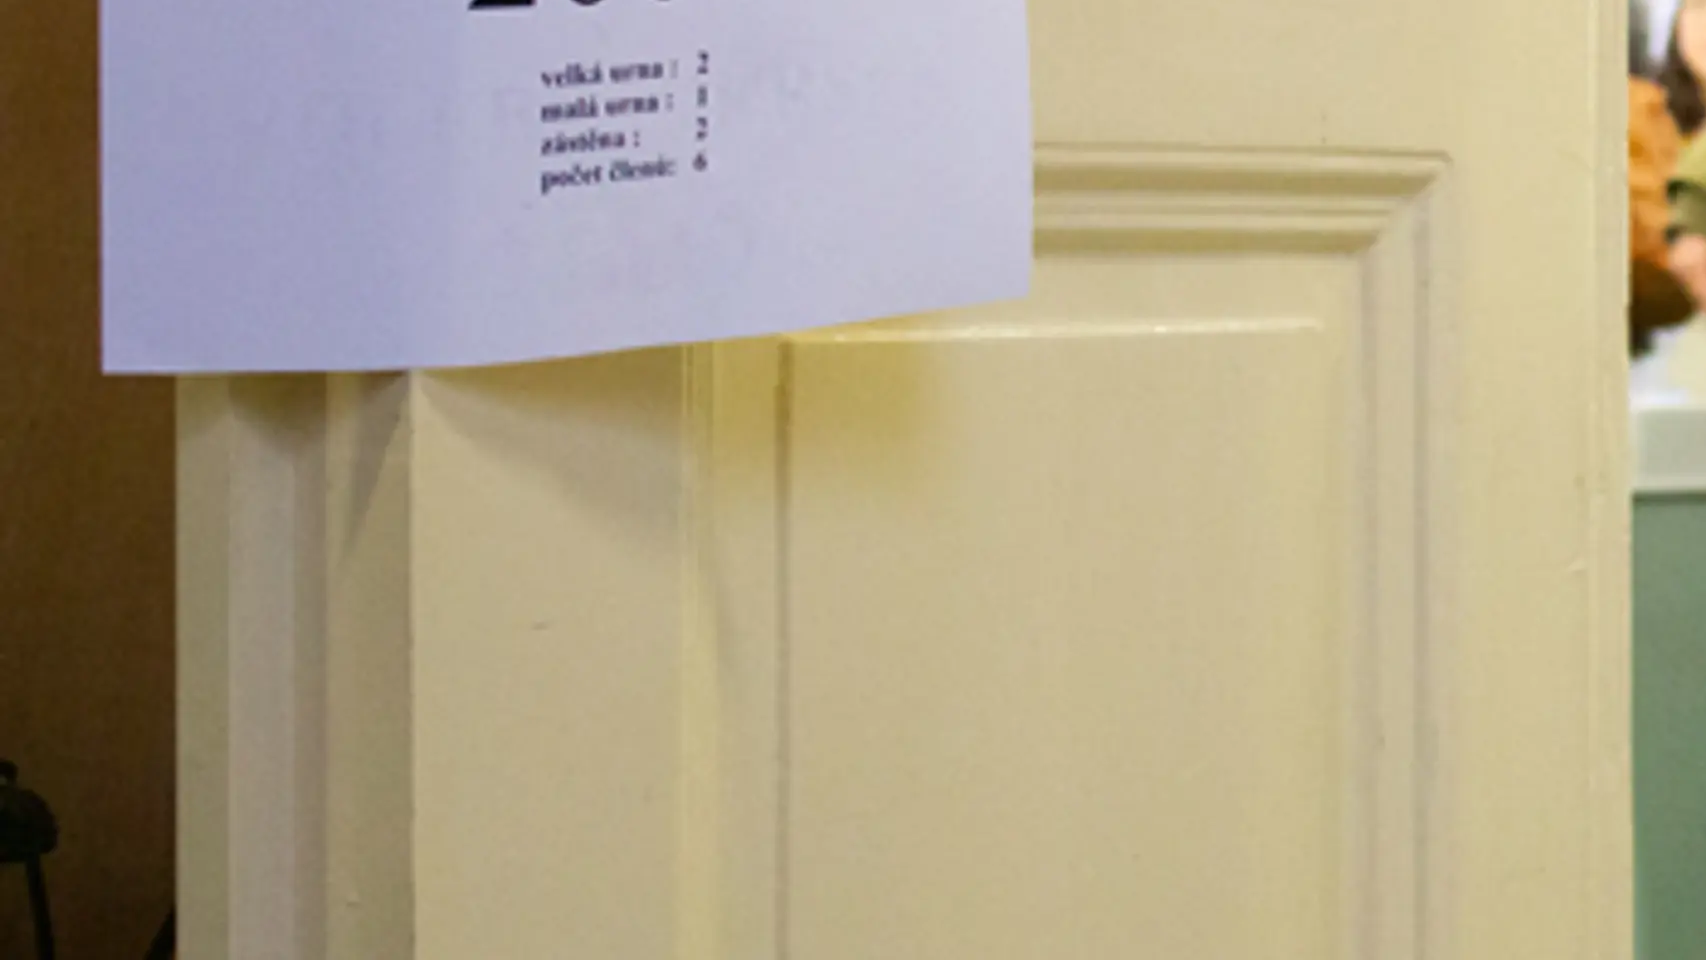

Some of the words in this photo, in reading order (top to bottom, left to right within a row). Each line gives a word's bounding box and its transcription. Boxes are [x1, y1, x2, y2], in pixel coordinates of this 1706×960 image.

[541, 60, 602, 86] velká
[609, 62, 664, 82] urna
[697, 50, 709, 74] 2
[541, 95, 598, 122] malá
[605, 97, 660, 116] urna
[696, 117, 708, 140] 2
[541, 163, 602, 195] počet
[692, 150, 708, 172] 6
